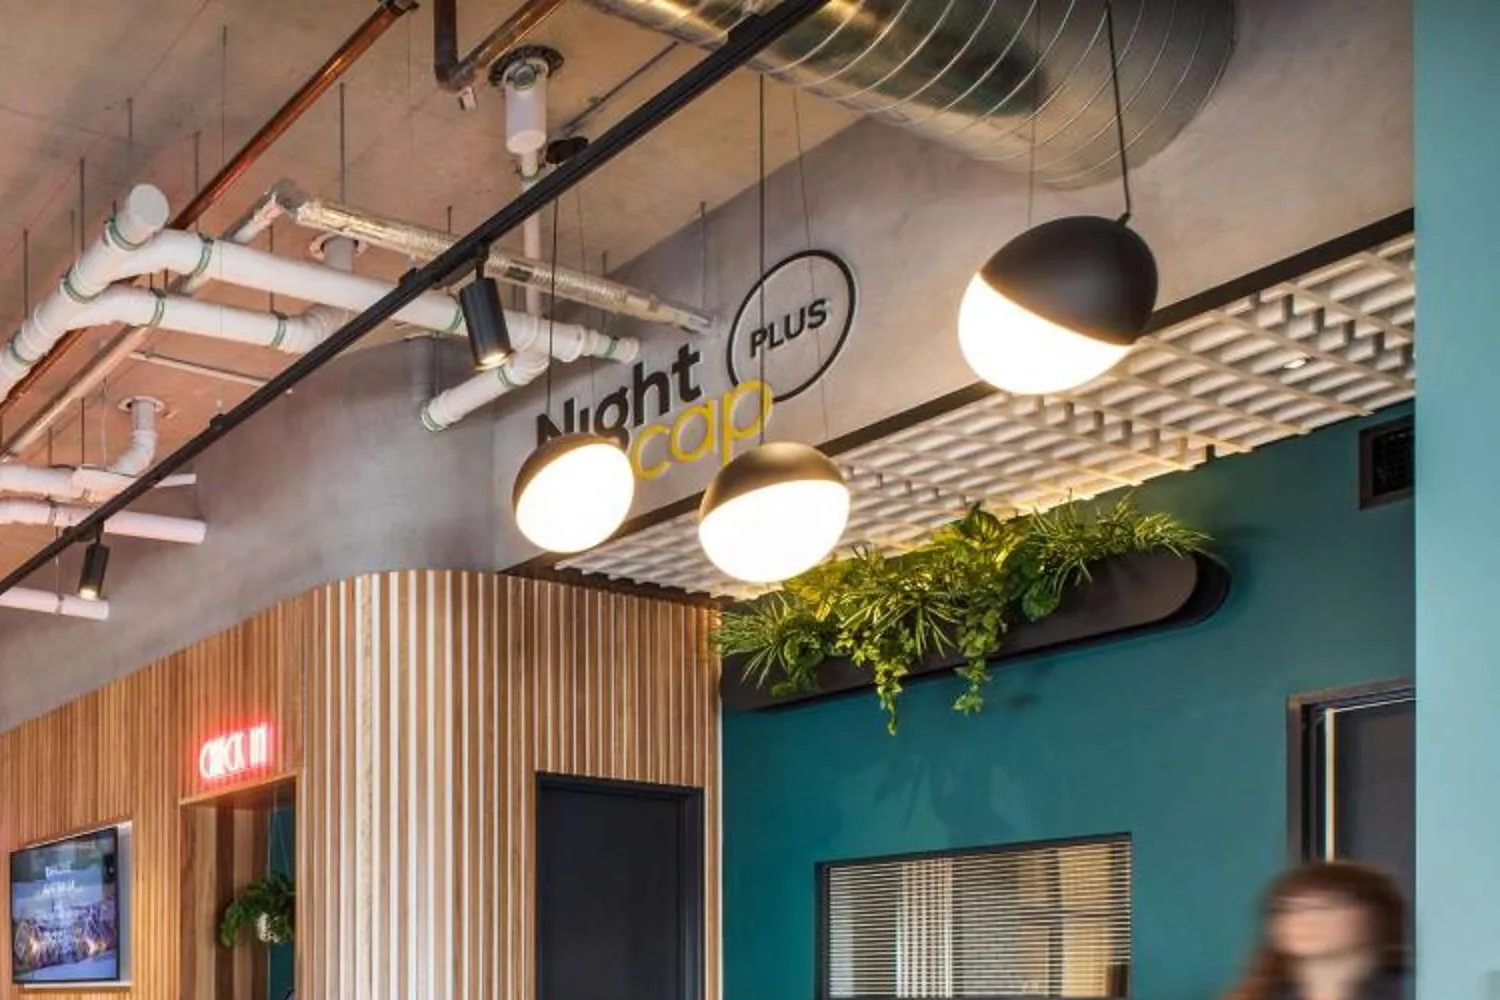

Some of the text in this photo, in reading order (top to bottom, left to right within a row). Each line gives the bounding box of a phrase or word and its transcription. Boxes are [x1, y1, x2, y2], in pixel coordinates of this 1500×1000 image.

[750, 298, 827, 358] PLUS
[536, 343, 701, 452] Night
[631, 379, 772, 480] cap
